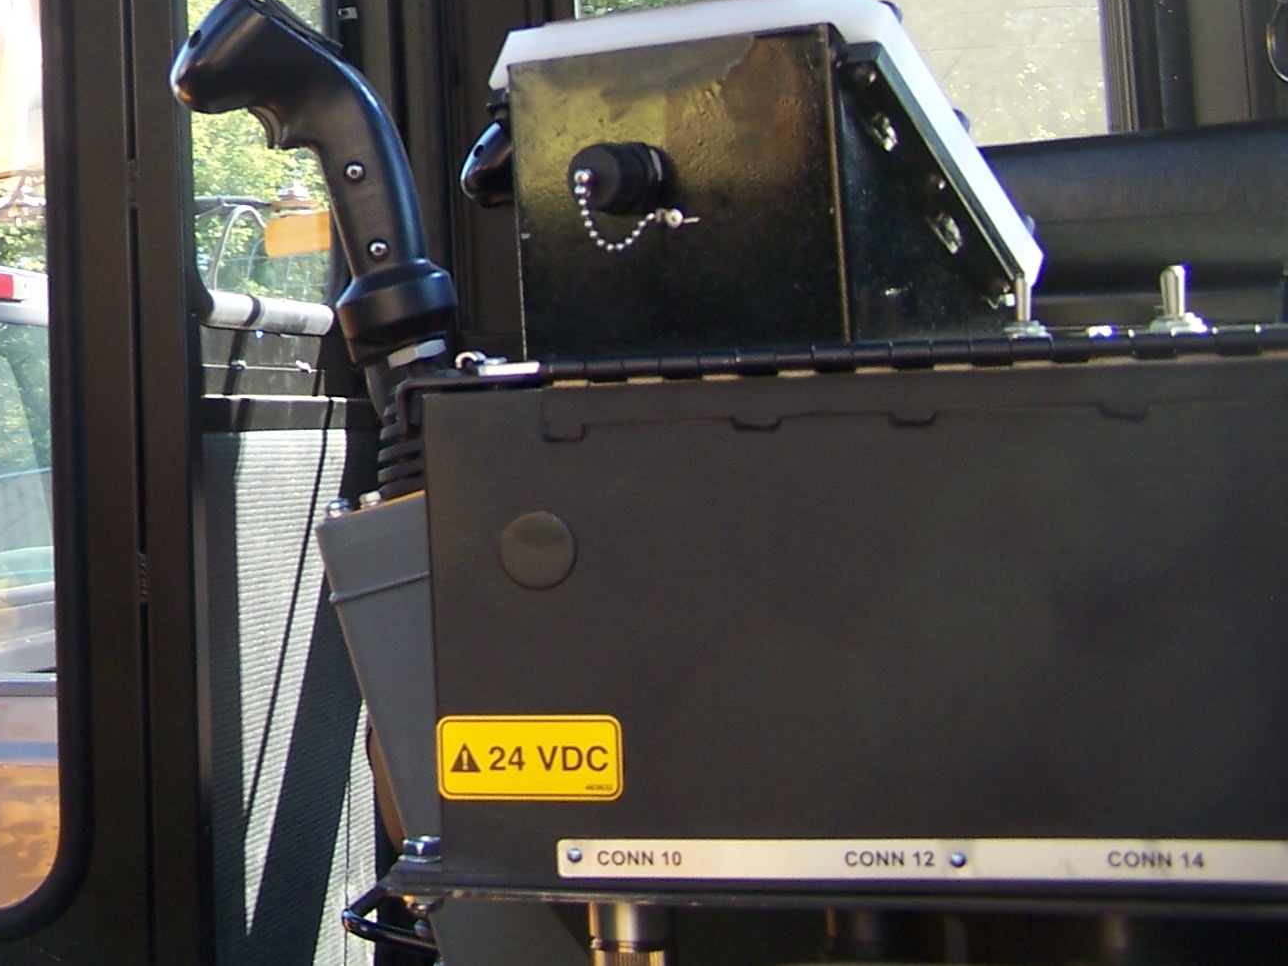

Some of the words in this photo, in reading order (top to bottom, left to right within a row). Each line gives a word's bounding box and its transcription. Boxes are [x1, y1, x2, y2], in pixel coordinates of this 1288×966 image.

[488, 745, 526, 771] 24
[536, 745, 609, 772] VDC
[596, 850, 655, 866] CONN
[661, 851, 682, 866] 10
[844, 850, 905, 867] CONN
[912, 851, 936, 867] 12
[1107, 850, 1173, 868] CONN
[1180, 851, 1205, 869] 14
